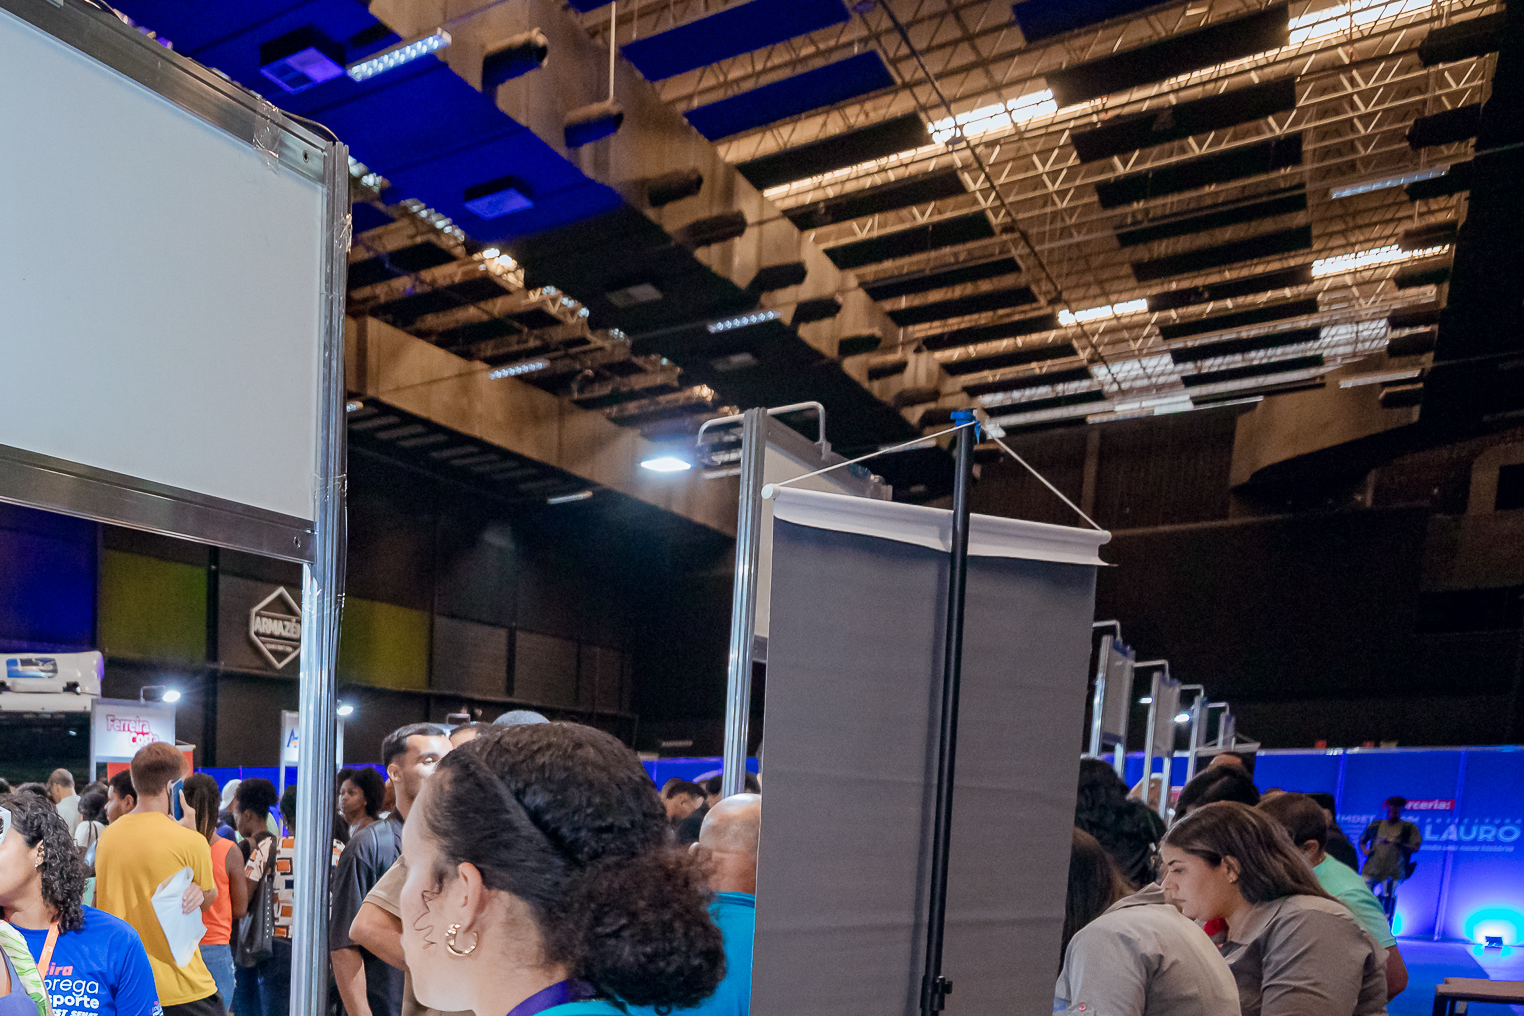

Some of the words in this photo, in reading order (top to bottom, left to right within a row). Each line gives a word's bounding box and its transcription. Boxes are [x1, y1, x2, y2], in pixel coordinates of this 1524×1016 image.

[253, 614, 302, 638] ARMAZÉ
[106, 713, 150, 733] Ferreira
[129, 732, 160, 747] Costa
[1405, 799, 1451, 811] rcerias
[1424, 823, 1522, 843] LAURO
